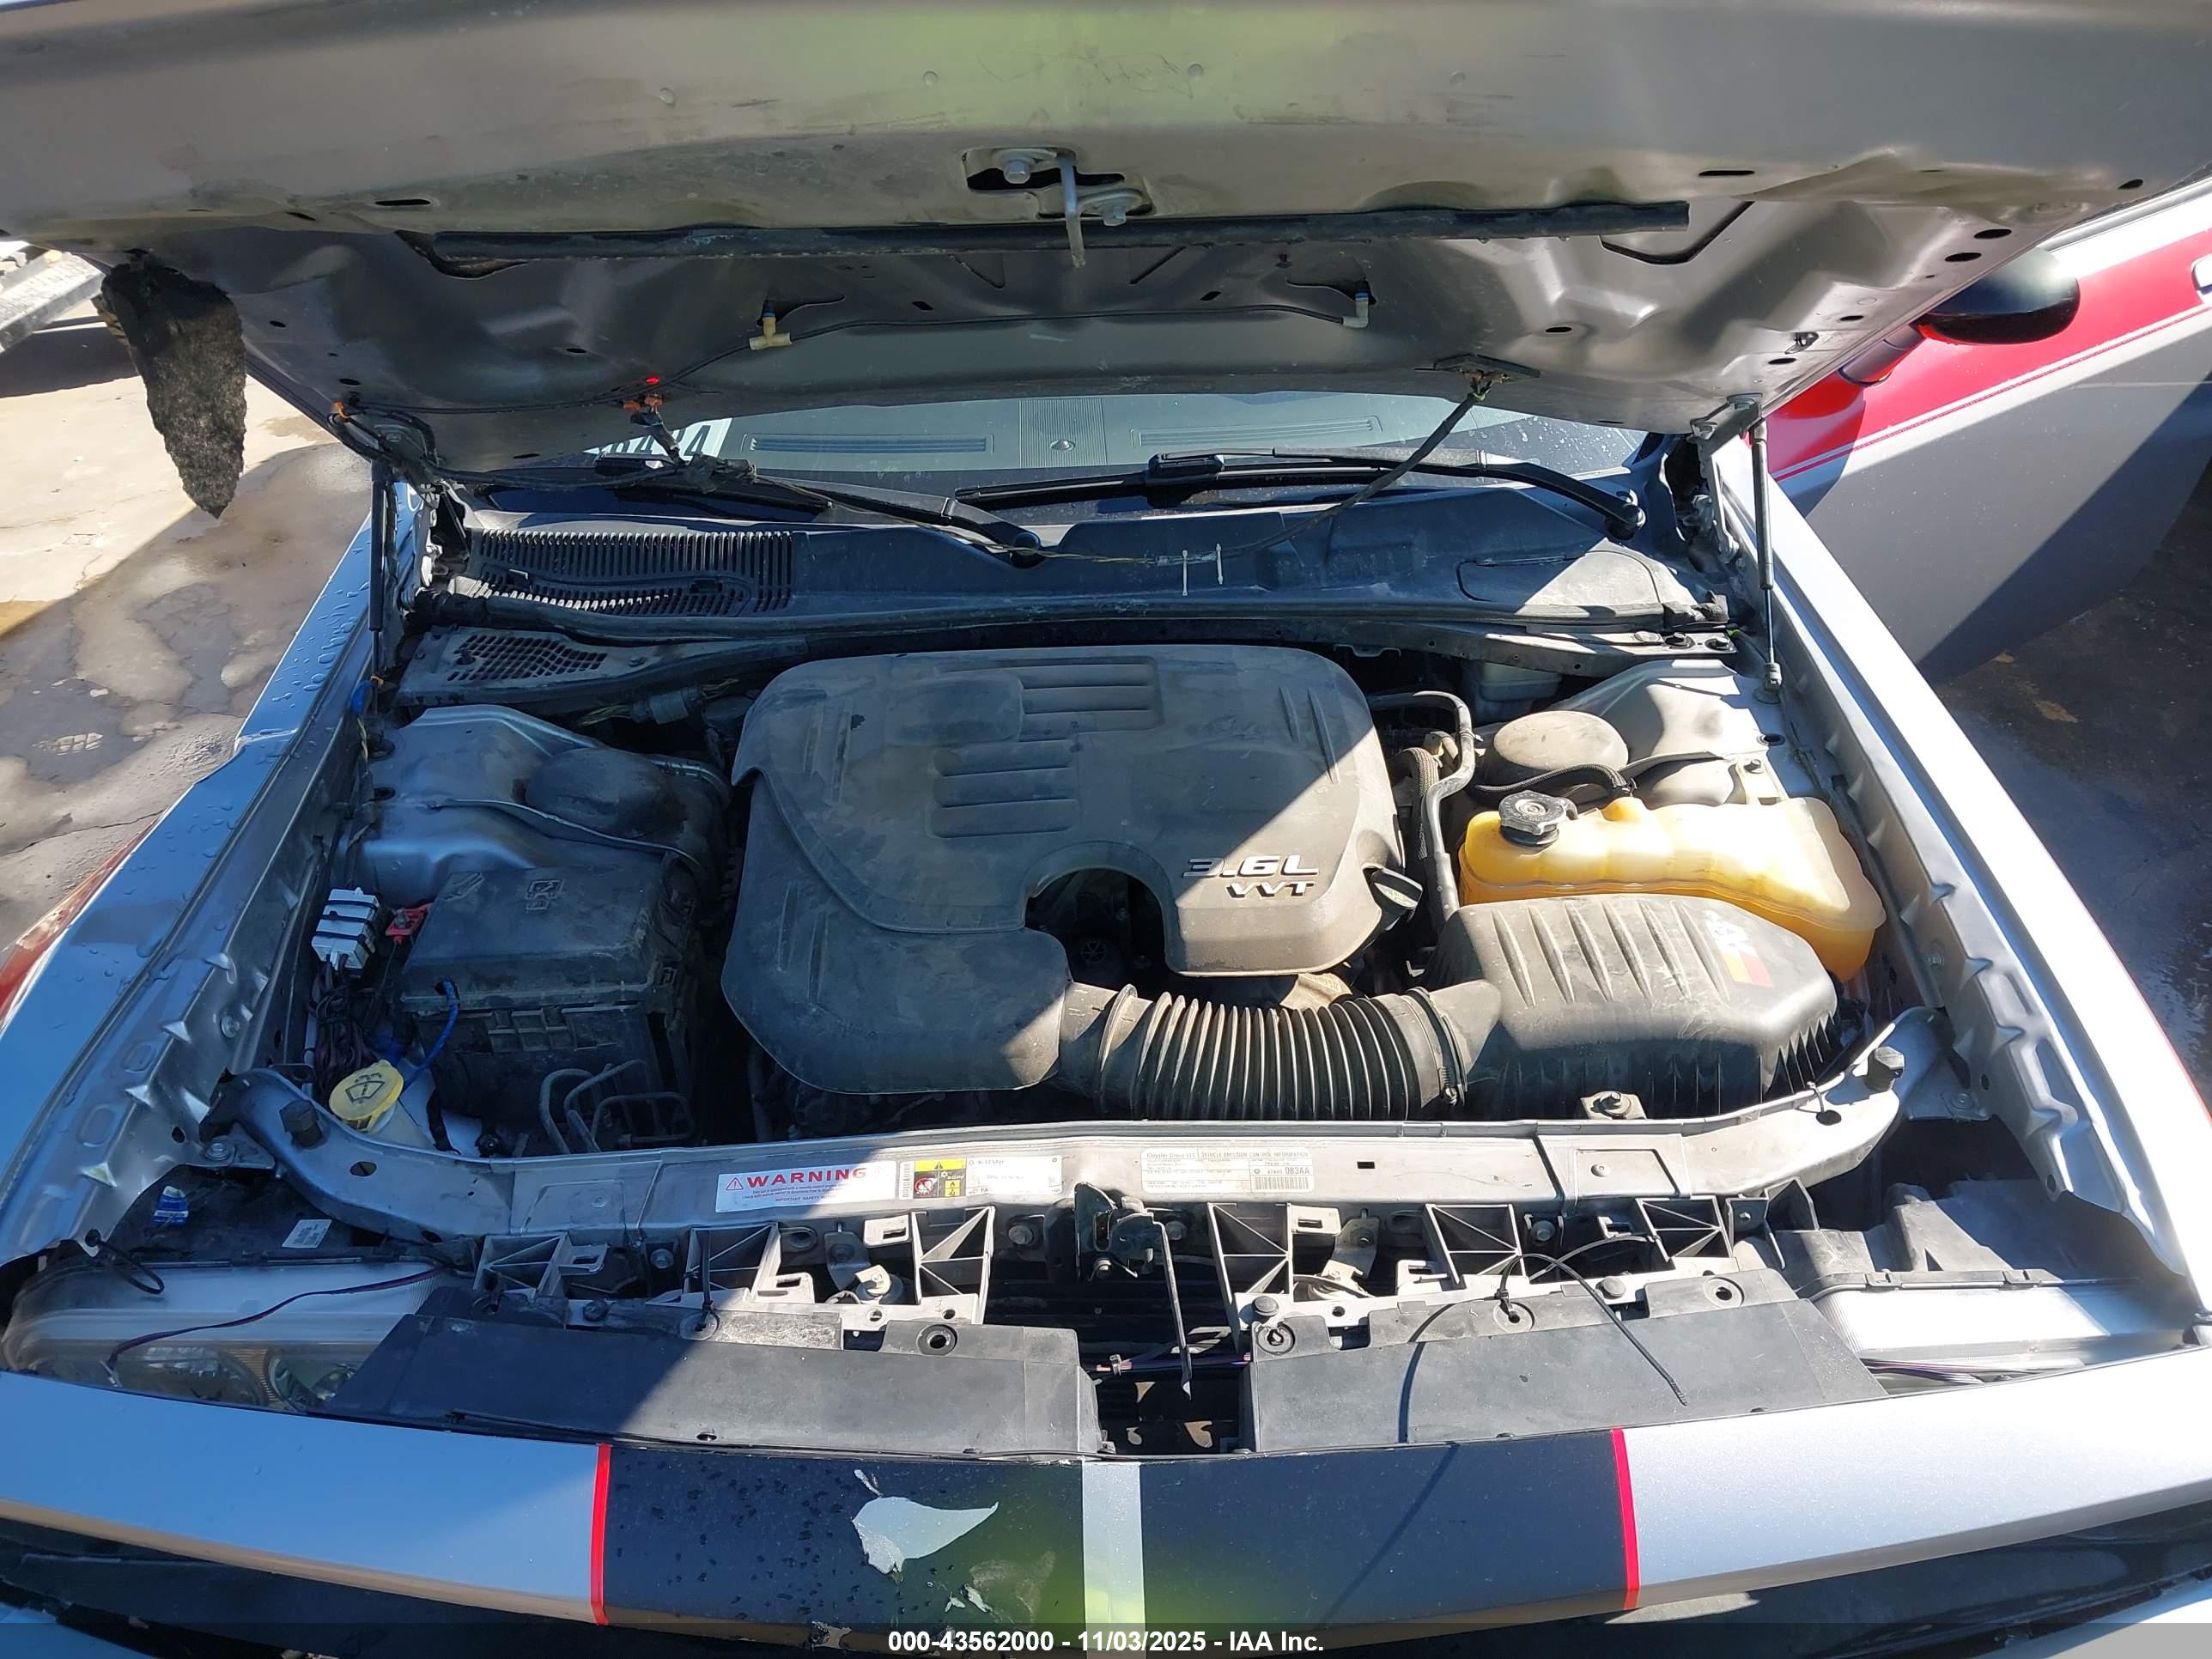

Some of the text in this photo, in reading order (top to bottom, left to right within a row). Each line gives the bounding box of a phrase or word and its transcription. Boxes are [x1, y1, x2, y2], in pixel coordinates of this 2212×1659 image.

[1182, 854, 1320, 878] 3.6L
[1225, 881, 1315, 898] VVT
[746, 1167, 866, 1188] WARNING
